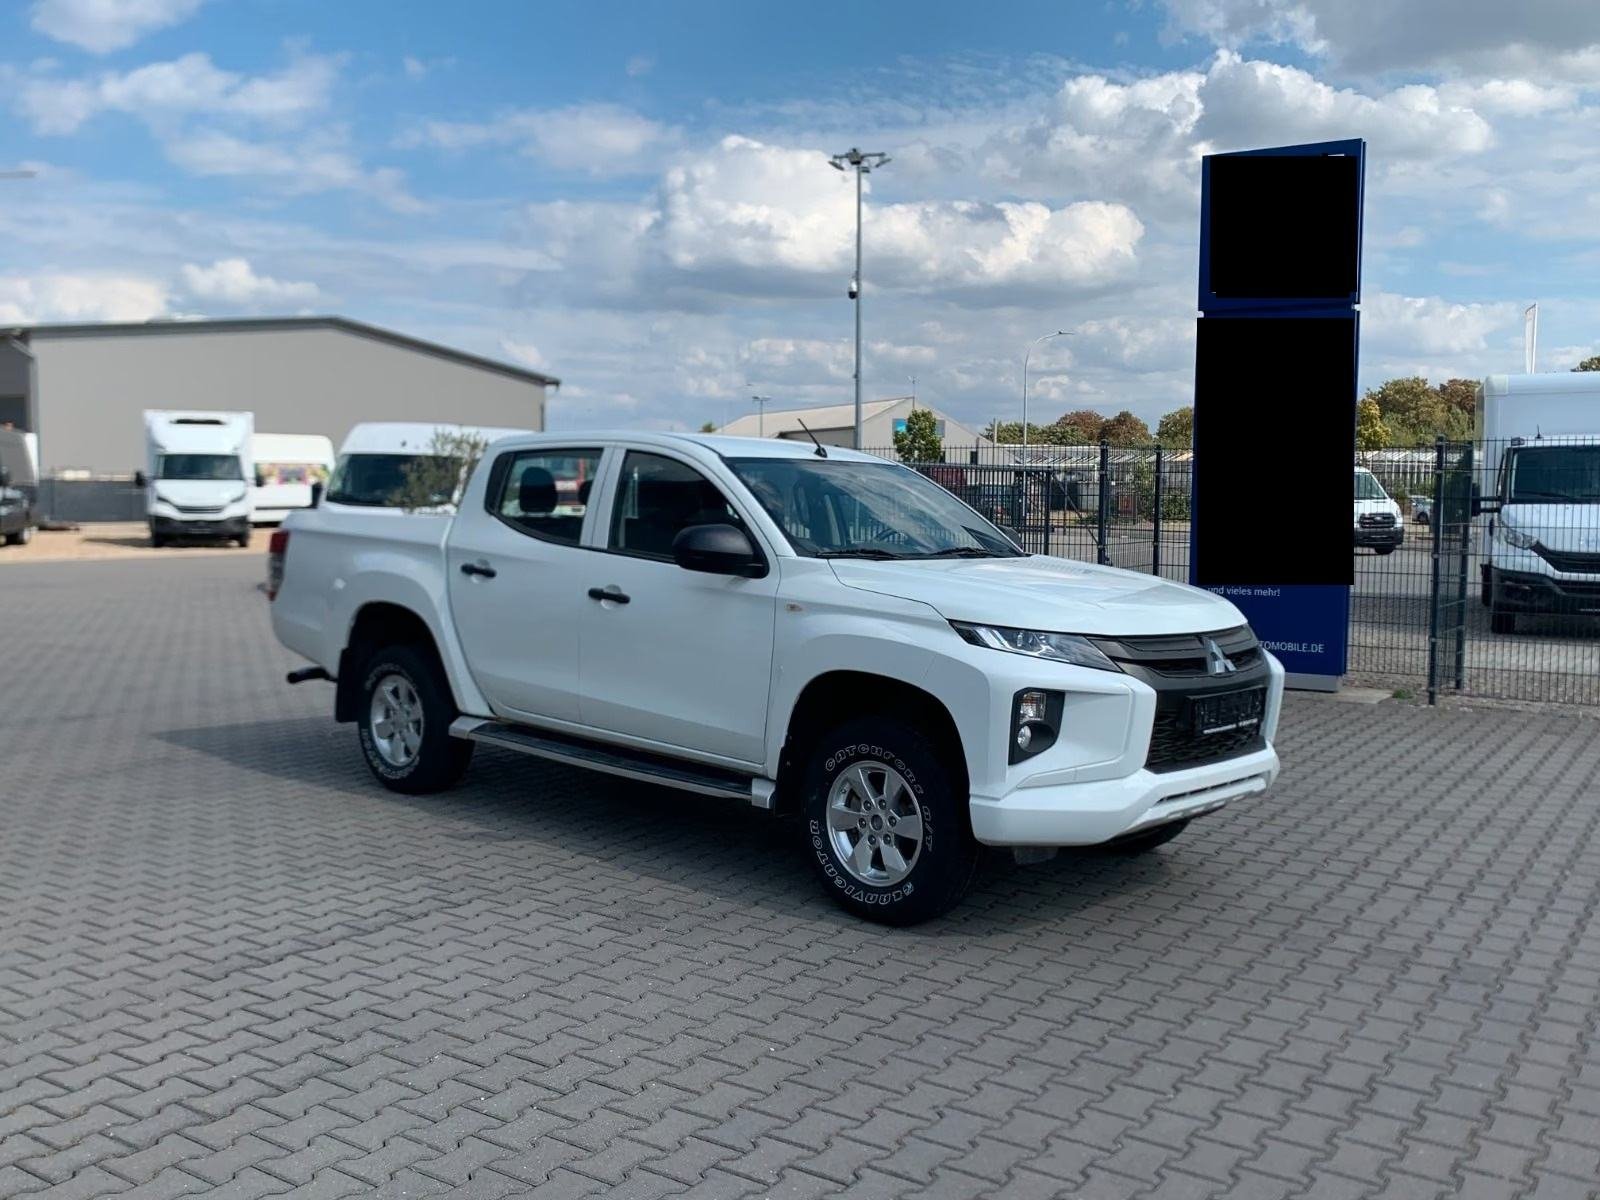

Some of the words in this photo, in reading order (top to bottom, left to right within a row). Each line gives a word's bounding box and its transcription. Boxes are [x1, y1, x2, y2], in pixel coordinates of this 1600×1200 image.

[1226, 587, 1252, 596] vieles
[1254, 588, 1281, 596] mehr!
[1257, 640, 1325, 654] TOMOBILE.DE
